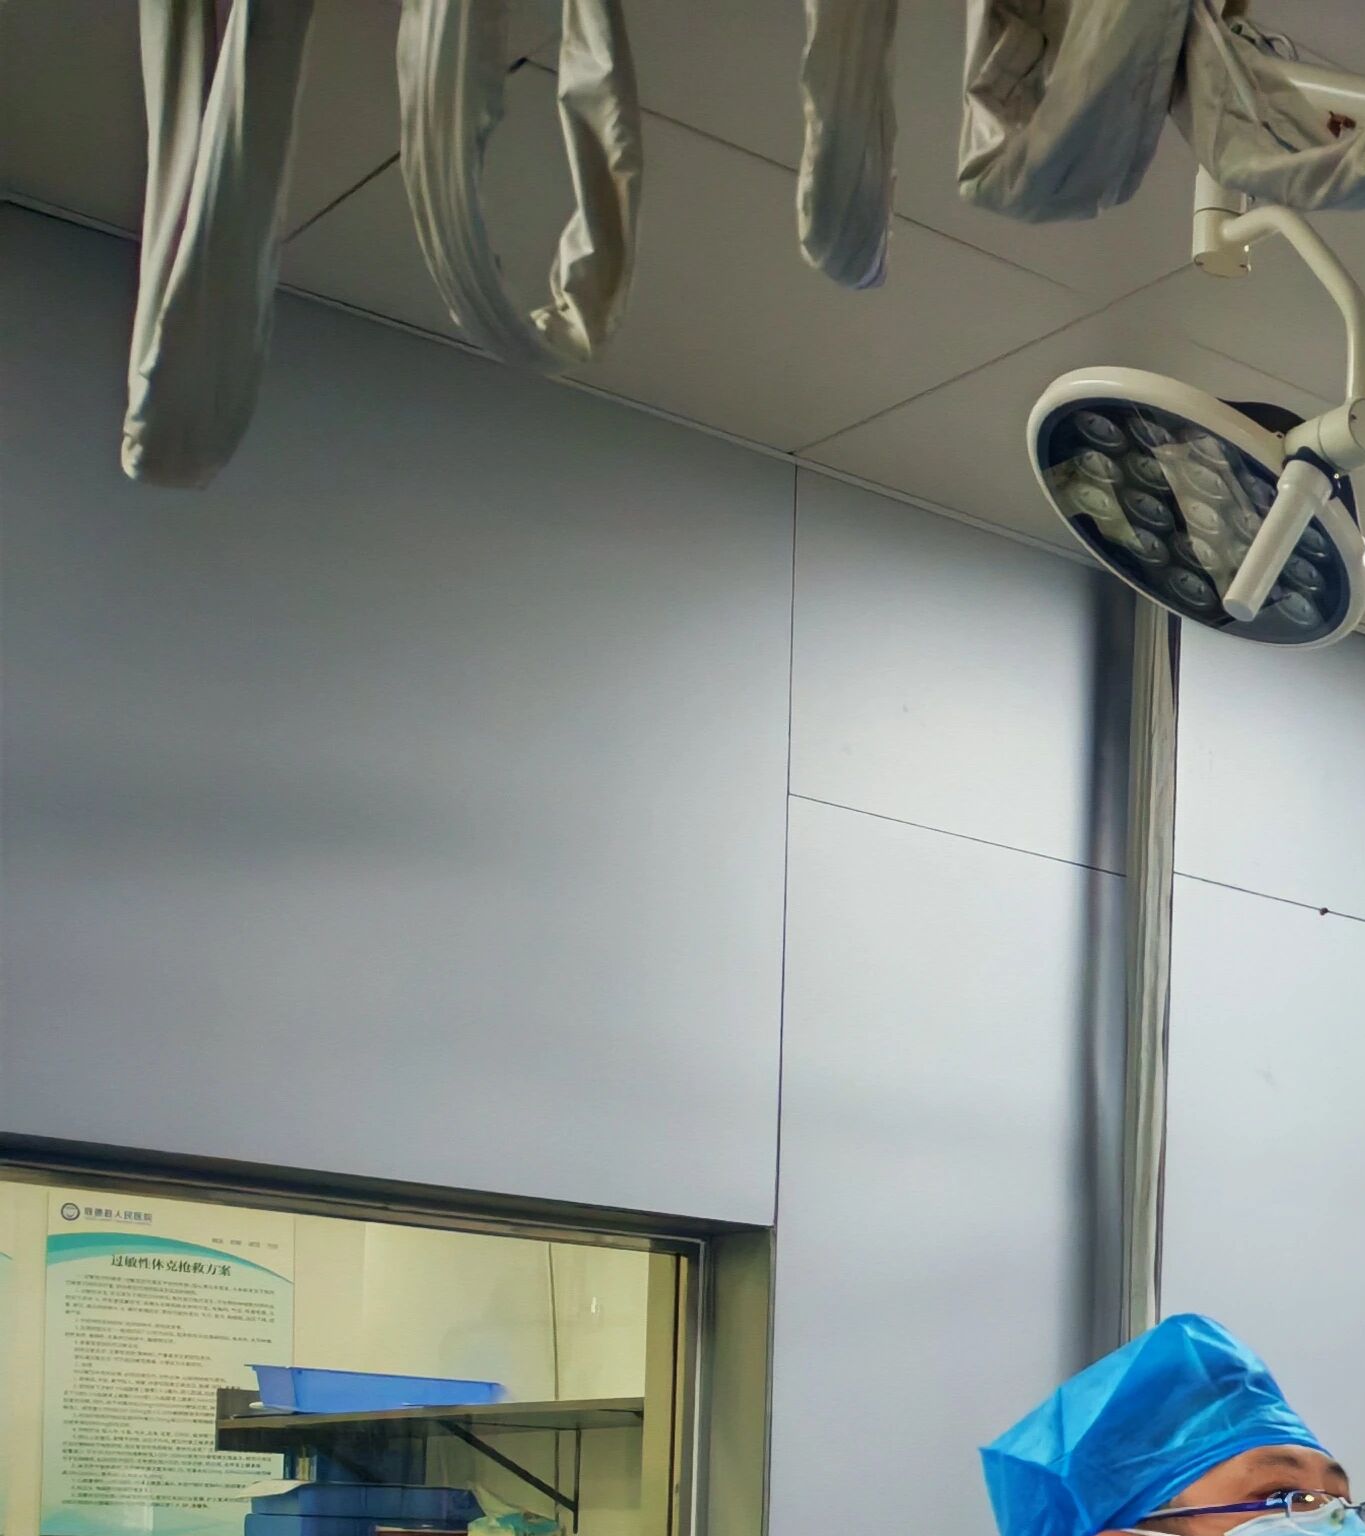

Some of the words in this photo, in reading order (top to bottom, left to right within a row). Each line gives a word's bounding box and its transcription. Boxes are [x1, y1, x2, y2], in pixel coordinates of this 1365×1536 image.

[111, 1254, 231, 1276] 过敏性休克抢救方案
